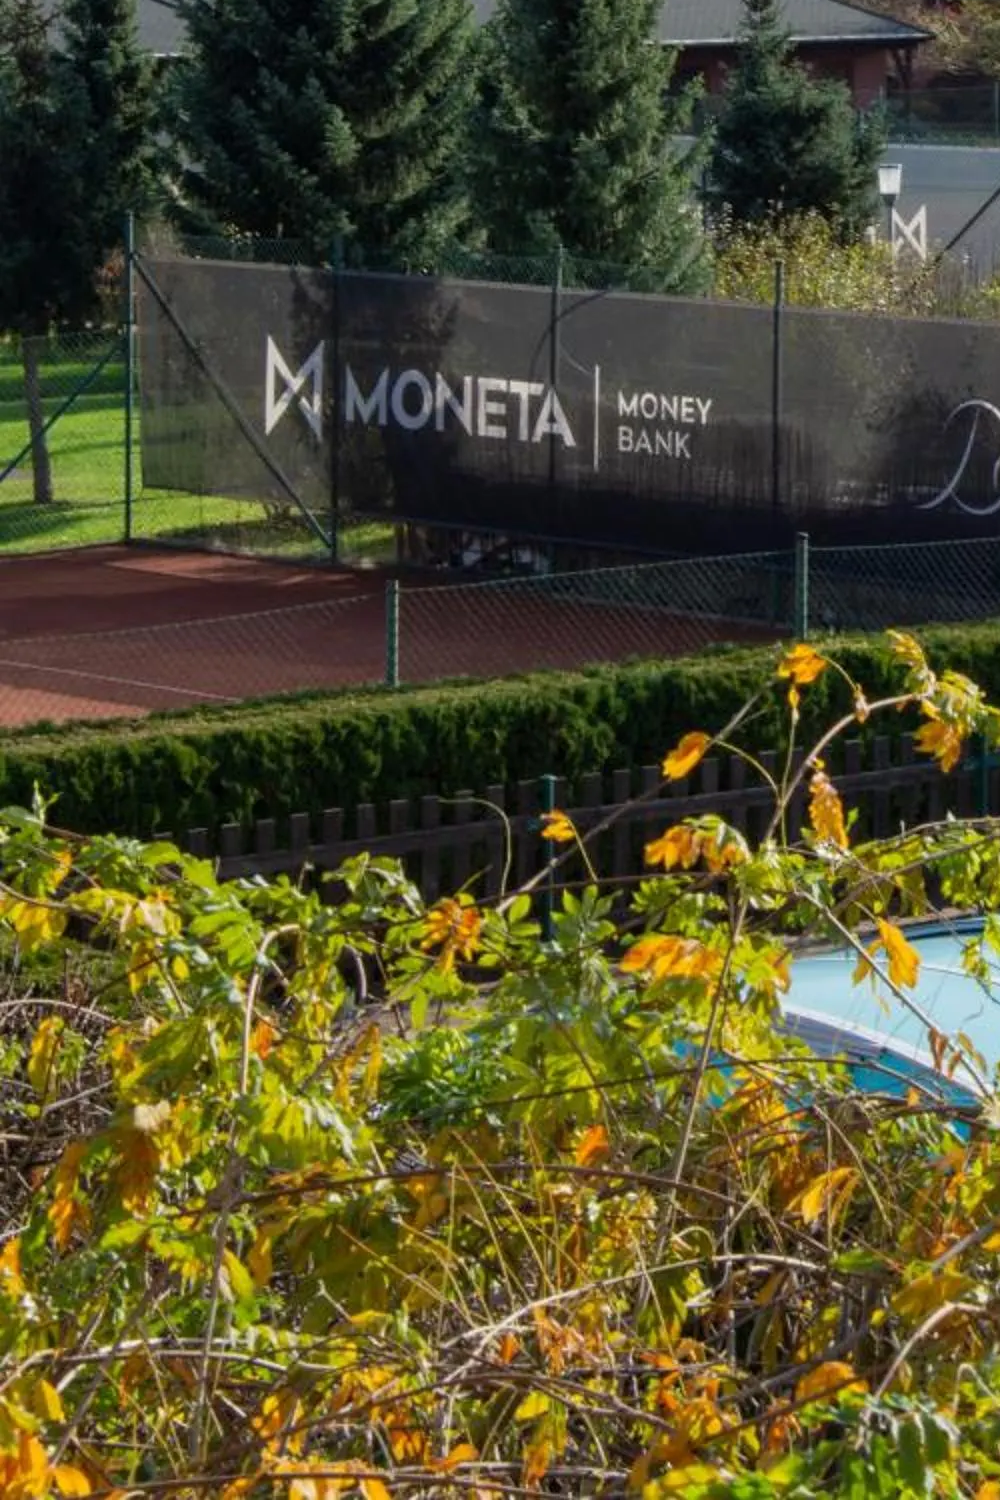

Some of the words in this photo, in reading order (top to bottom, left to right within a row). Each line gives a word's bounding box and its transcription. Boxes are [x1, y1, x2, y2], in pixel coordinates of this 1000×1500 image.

[344, 364, 576, 448] MONETA
[618, 391, 712, 425] MONEY
[618, 426, 691, 459] BANK
